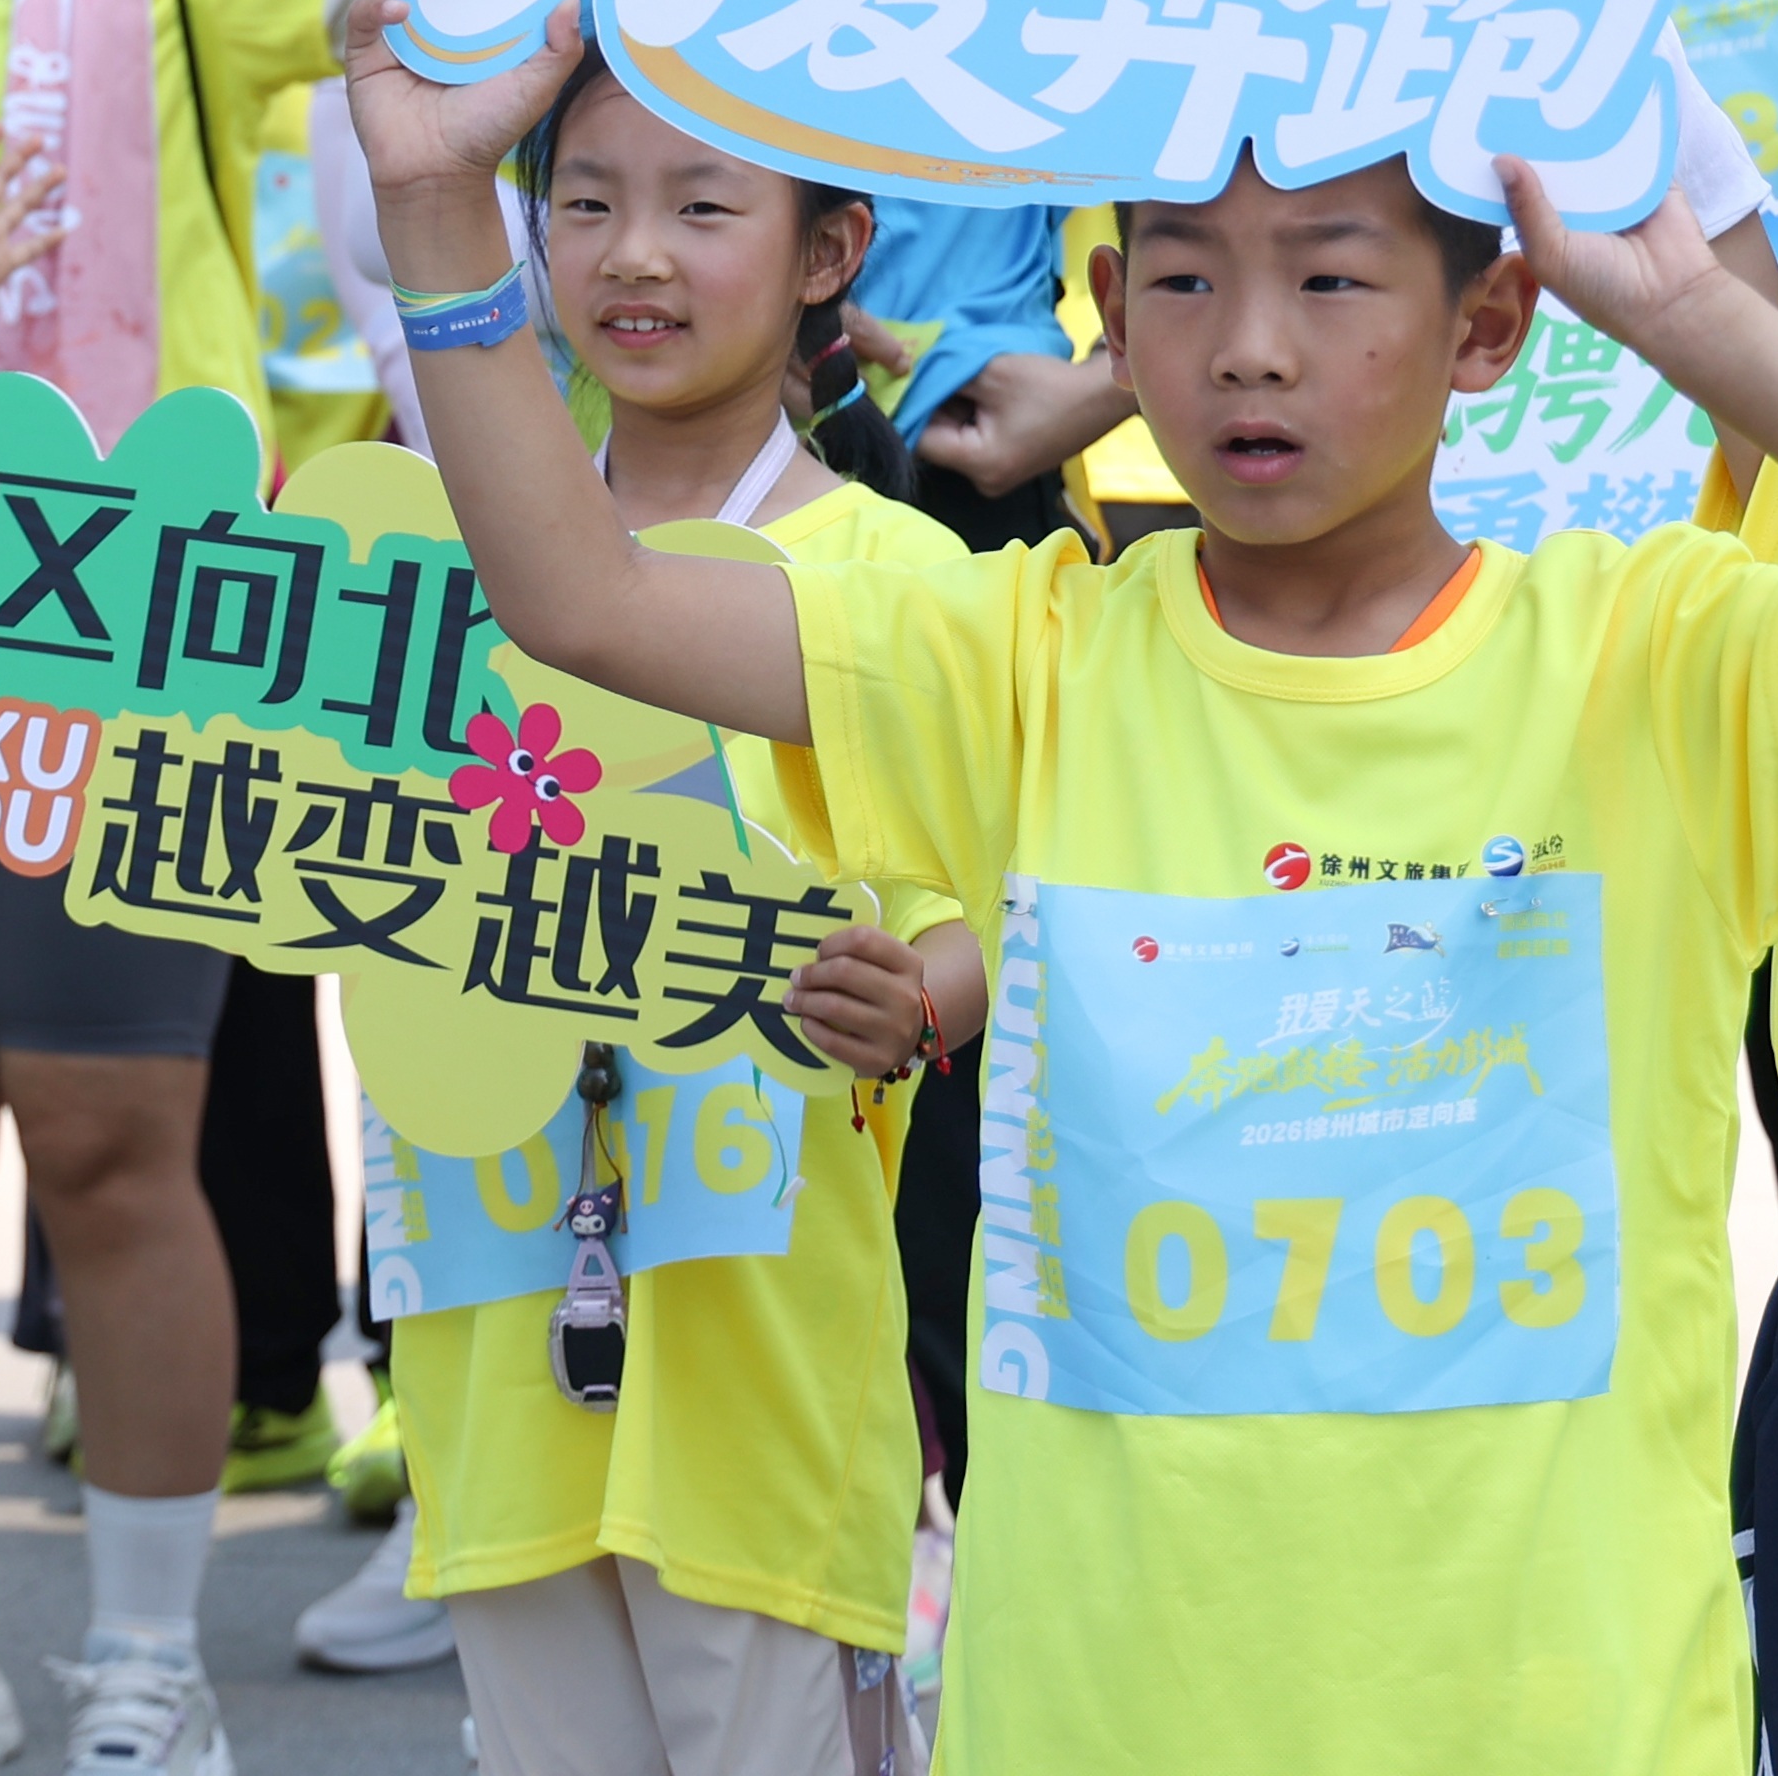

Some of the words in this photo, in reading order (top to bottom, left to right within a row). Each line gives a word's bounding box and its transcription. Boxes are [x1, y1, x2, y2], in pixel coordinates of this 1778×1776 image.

[88, 727, 855, 1070] 越变越美
[473, 1082, 772, 1232] 016
[1124, 1186, 1586, 1343] 0703
